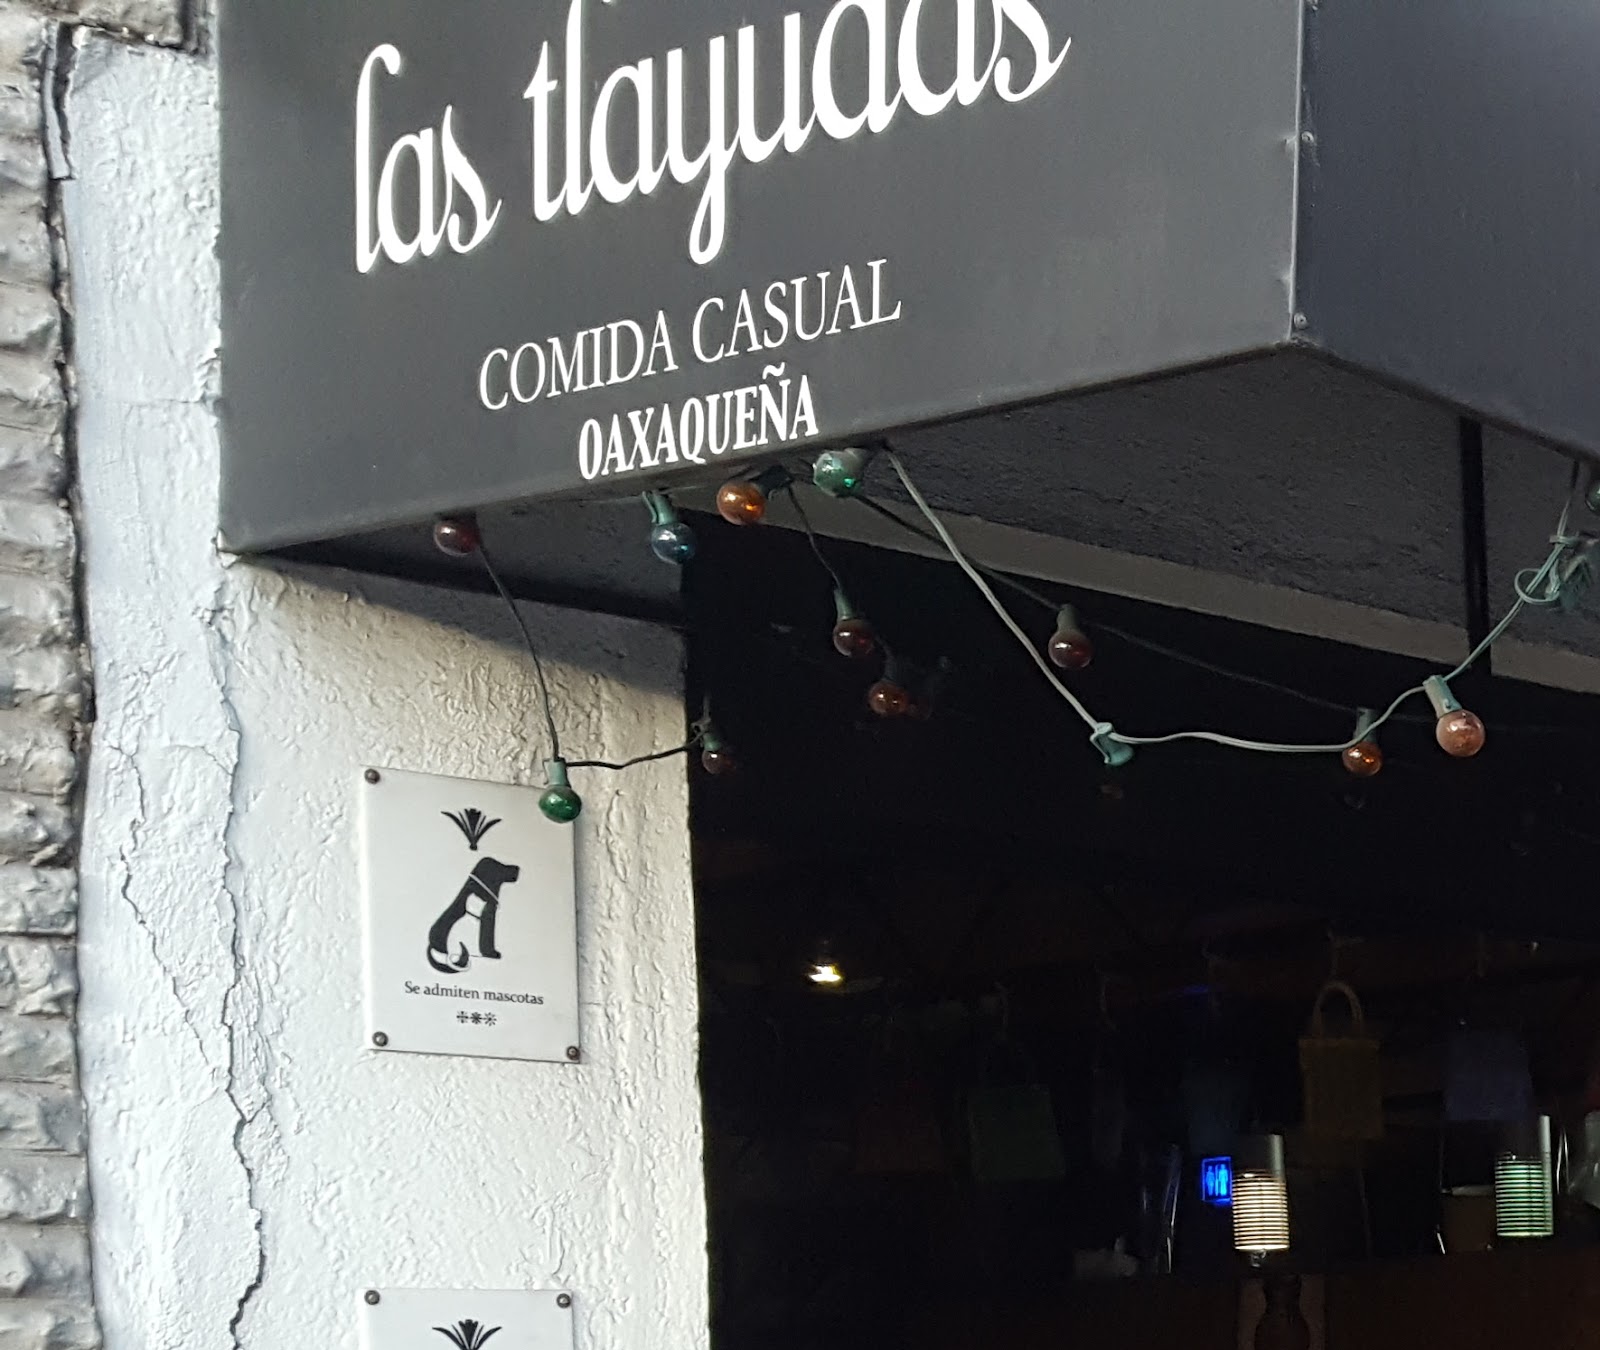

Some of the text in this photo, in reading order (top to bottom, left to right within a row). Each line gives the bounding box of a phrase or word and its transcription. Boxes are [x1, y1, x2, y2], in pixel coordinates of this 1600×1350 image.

[355, 43, 502, 275] las
[479, 258, 903, 411] COMIDA CASUAL
[578, 365, 819, 481] OAXAQUEÑA
[405, 981, 544, 1005] Se admiten mascotas
